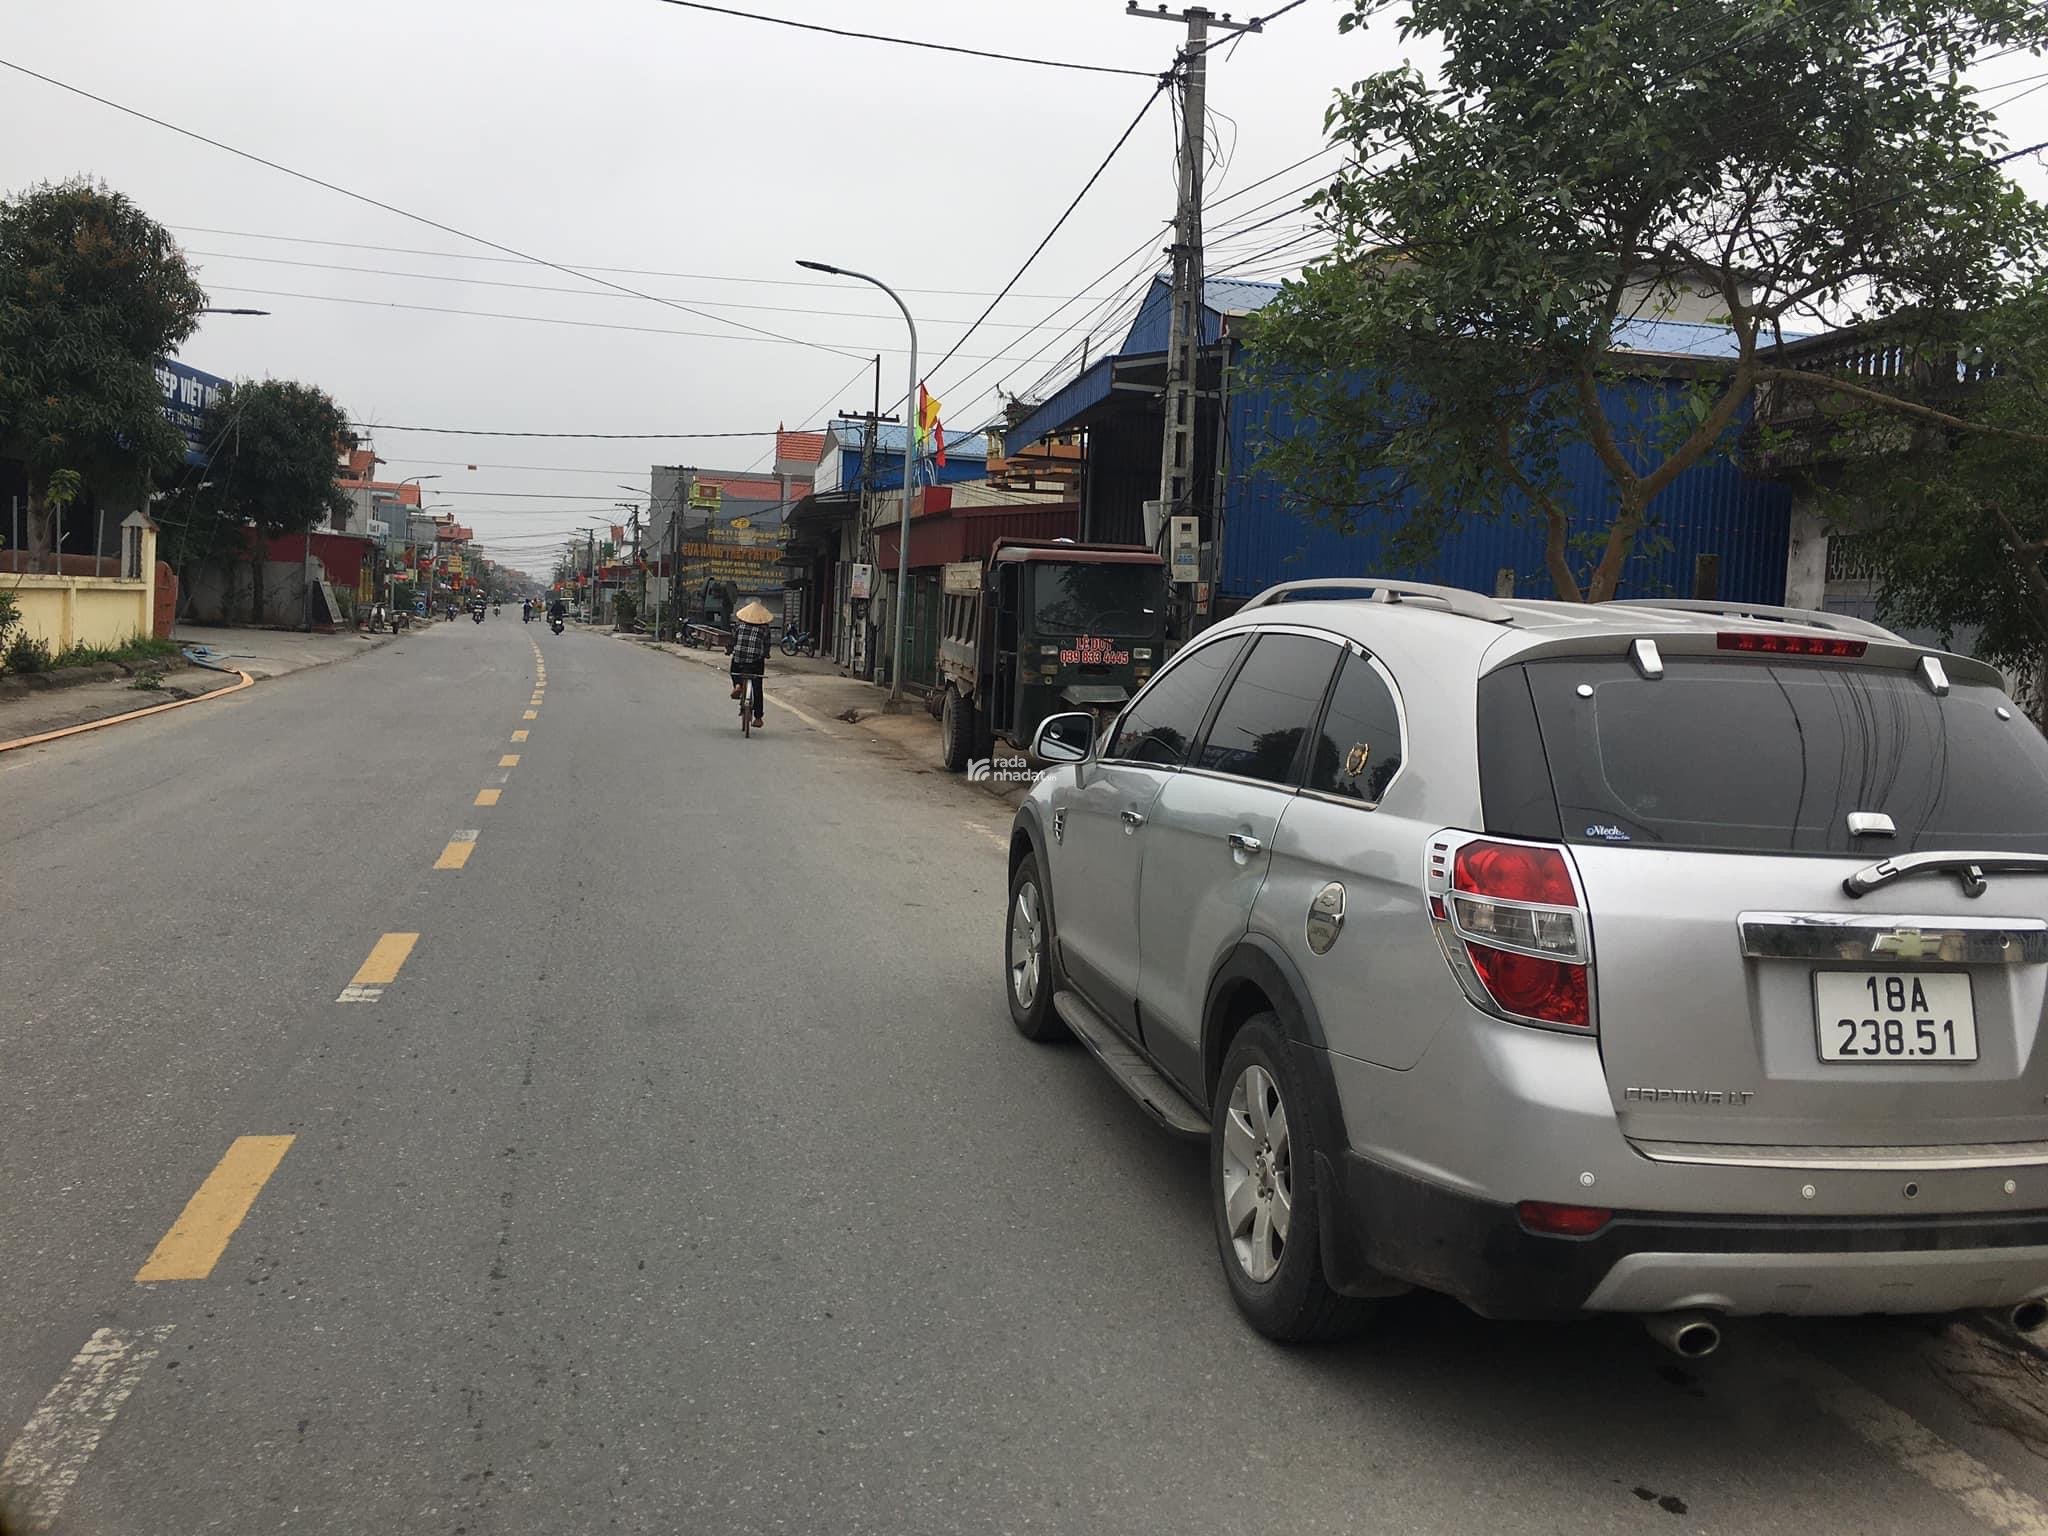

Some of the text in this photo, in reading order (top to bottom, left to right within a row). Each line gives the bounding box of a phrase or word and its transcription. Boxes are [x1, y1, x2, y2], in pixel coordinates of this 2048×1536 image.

[180, 376, 204, 411] VIỆT
[1076, 634, 1089, 650] LÊ
[1060, 649, 1080, 663] 039
[1081, 650, 1101, 663] 833
[1866, 976, 1929, 1012] 18A
[1837, 1019, 1956, 1055] 238.51
[1624, 1087, 1756, 1105] CAPTIVA LT
